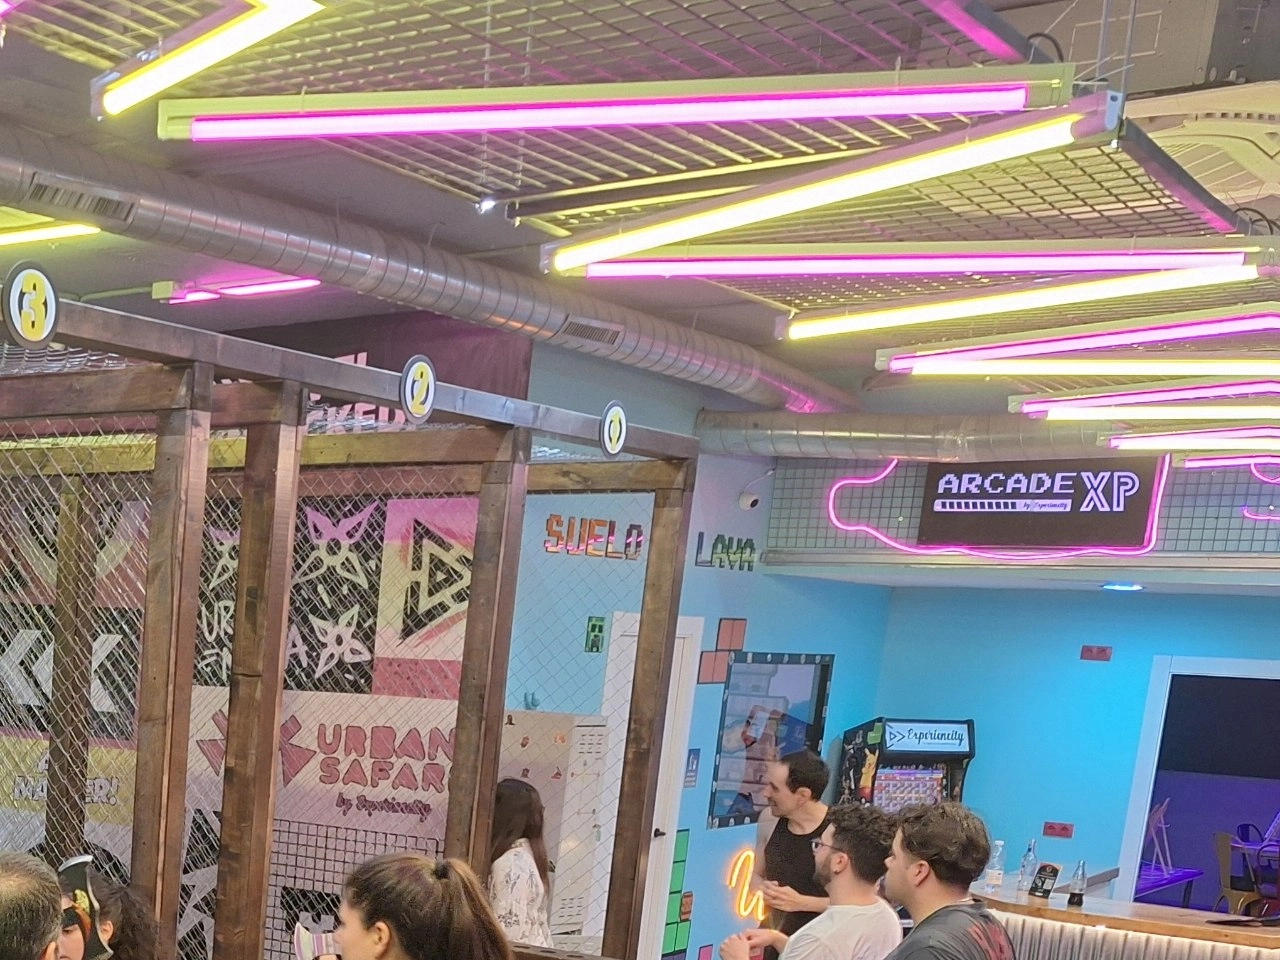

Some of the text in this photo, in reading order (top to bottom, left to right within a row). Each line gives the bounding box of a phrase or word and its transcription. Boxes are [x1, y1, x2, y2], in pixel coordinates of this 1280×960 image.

[21, 272, 46, 340] 3
[411, 361, 430, 415] 2
[937, 471, 1141, 512] ARCADE XP
[544, 513, 643, 560] SUELO
[695, 531, 755, 572] LAVA
[317, 723, 456, 762] URBAN
[319, 756, 446, 794] SAFAR
